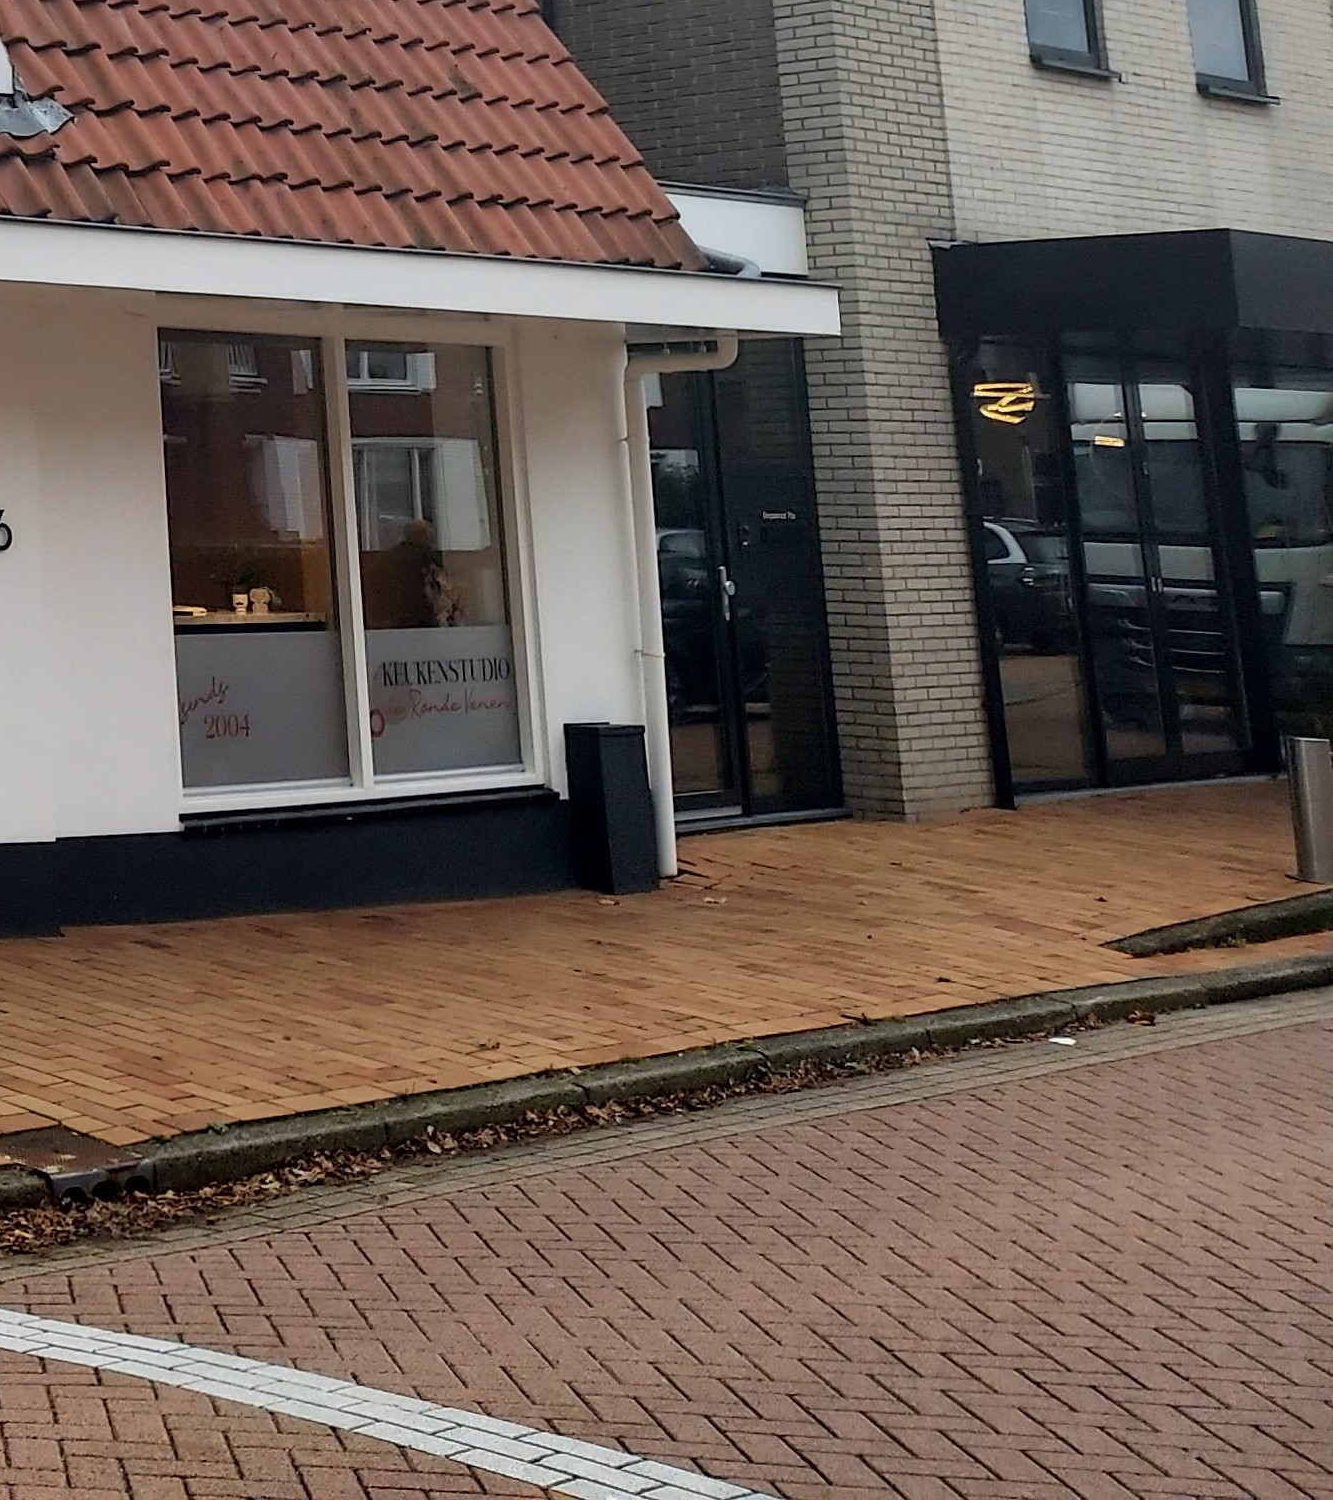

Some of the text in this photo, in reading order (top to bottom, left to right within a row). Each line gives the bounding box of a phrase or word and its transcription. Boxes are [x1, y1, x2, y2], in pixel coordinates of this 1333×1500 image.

[382, 657, 511, 687] KEUKENSTUDIO
[408, 688, 462, 718] Ronde
[203, 713, 251, 739] 2004
